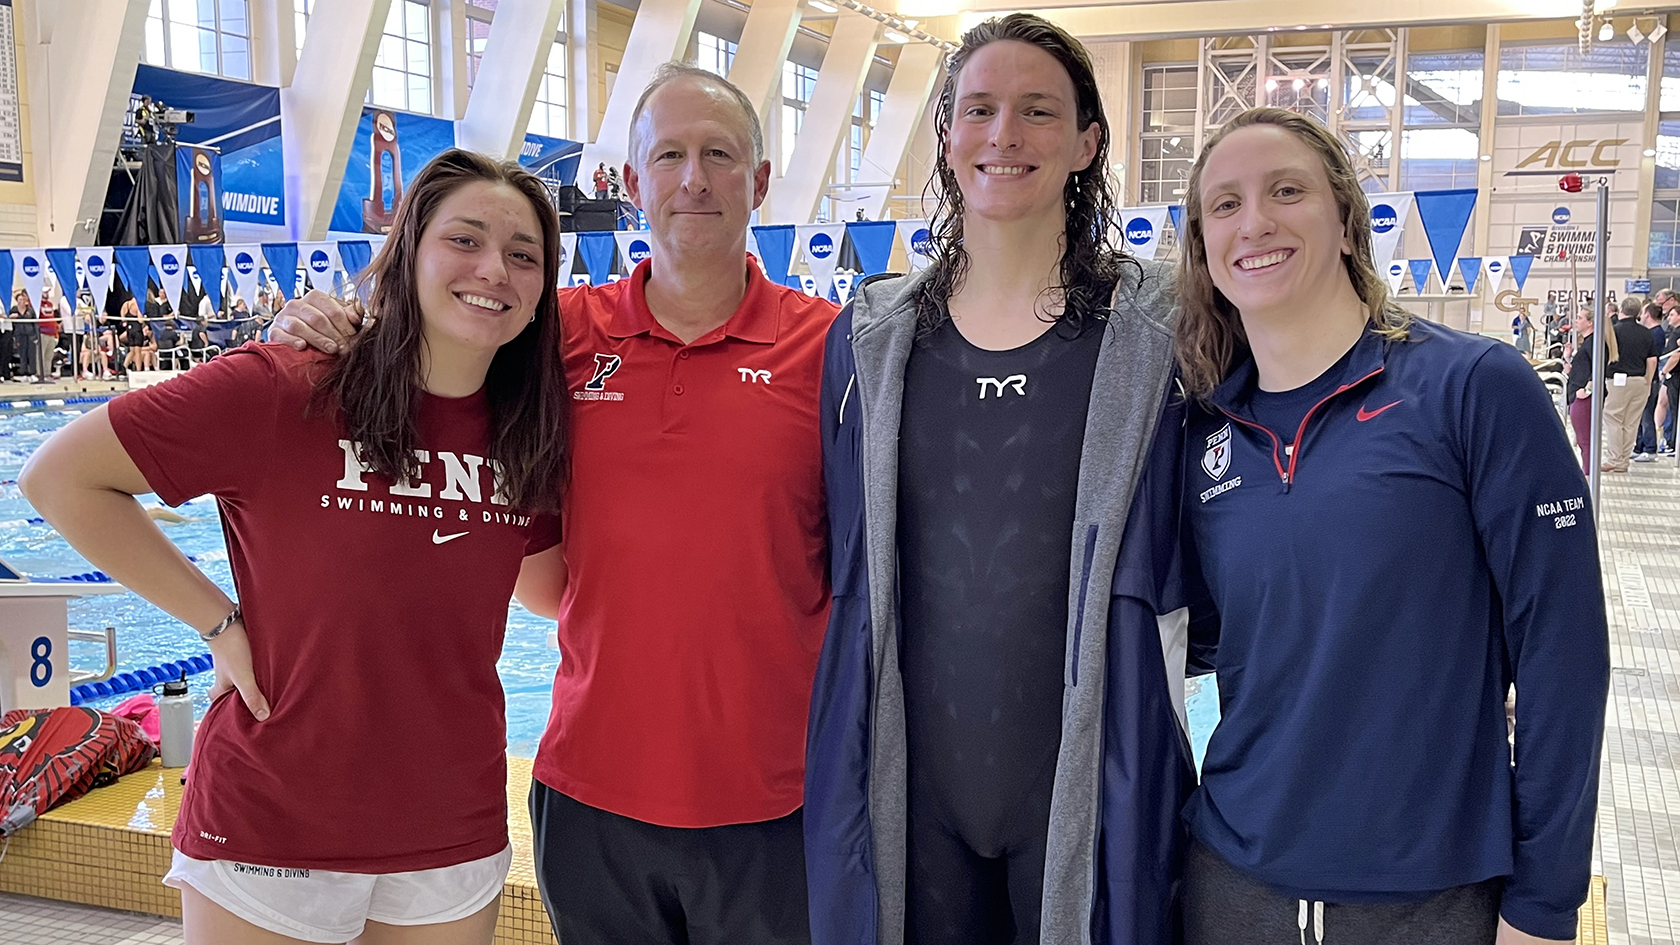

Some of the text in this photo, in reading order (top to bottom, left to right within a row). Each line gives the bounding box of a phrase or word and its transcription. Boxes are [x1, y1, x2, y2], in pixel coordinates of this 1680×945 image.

[1515, 138, 1630, 168] ACC
[222, 191, 279, 215] WIMDIVE
[1371, 217, 1397, 226] NCAA
[1128, 230, 1153, 239] NCAA
[1549, 231, 1612, 242] SWIMMIG
[631, 251, 651, 259] NCAA
[812, 245, 833, 253] NCAA
[1546, 243, 1594, 254] & DIVING
[237, 262, 253, 270] NCAA
[312, 260, 330, 268] NCAA
[1548, 290, 1617, 302] GERA
[585, 353, 622, 390] P
[737, 367, 772, 384] TYR
[976, 374, 1027, 399] TYR
[1206, 428, 1229, 448] PENN
[1200, 476, 1242, 503] SWIMMING
[320, 494, 531, 527] SWIMMING & DIVING
[1536, 496, 1584, 517] NCAA TEAM
[1554, 513, 1576, 529] 2022
[30, 636, 52, 687] 8
[200, 831, 227, 844] DRI-FIT
[234, 863, 310, 878] SWIMMING & DIVING
